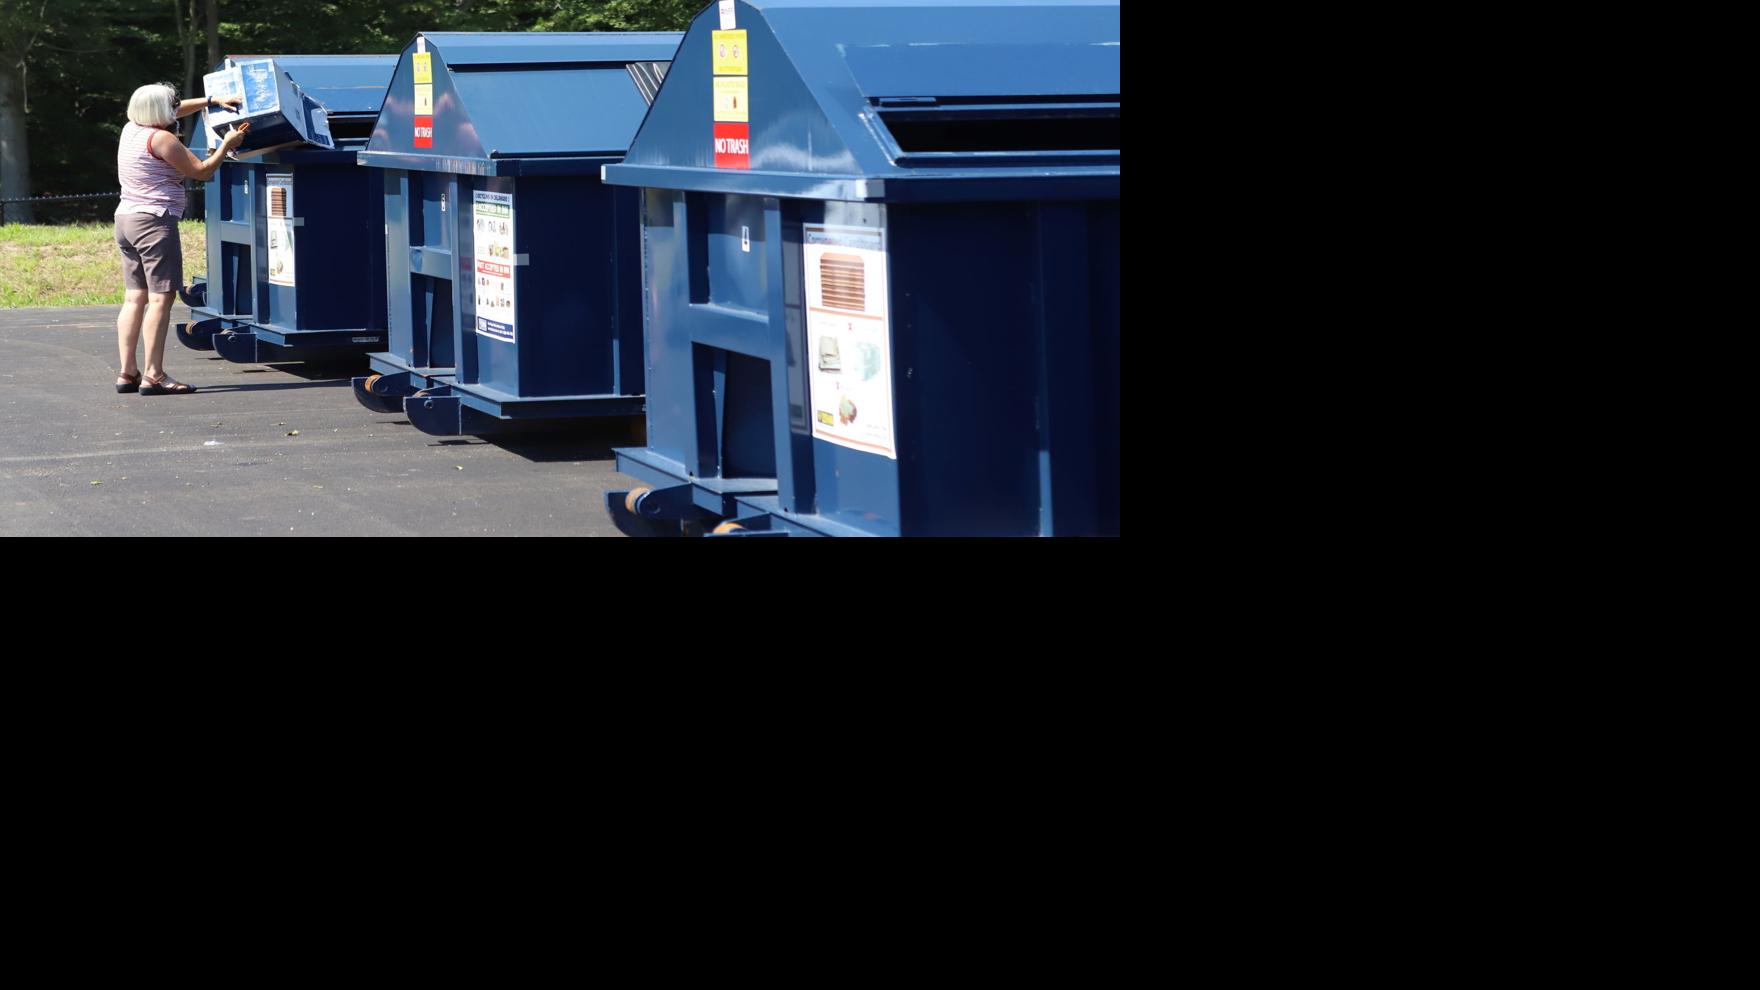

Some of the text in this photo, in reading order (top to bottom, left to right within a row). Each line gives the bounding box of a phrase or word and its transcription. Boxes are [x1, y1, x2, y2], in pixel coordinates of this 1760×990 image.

[414, 127, 433, 138] NO TRASH
[715, 138, 749, 154] NO TRASH
